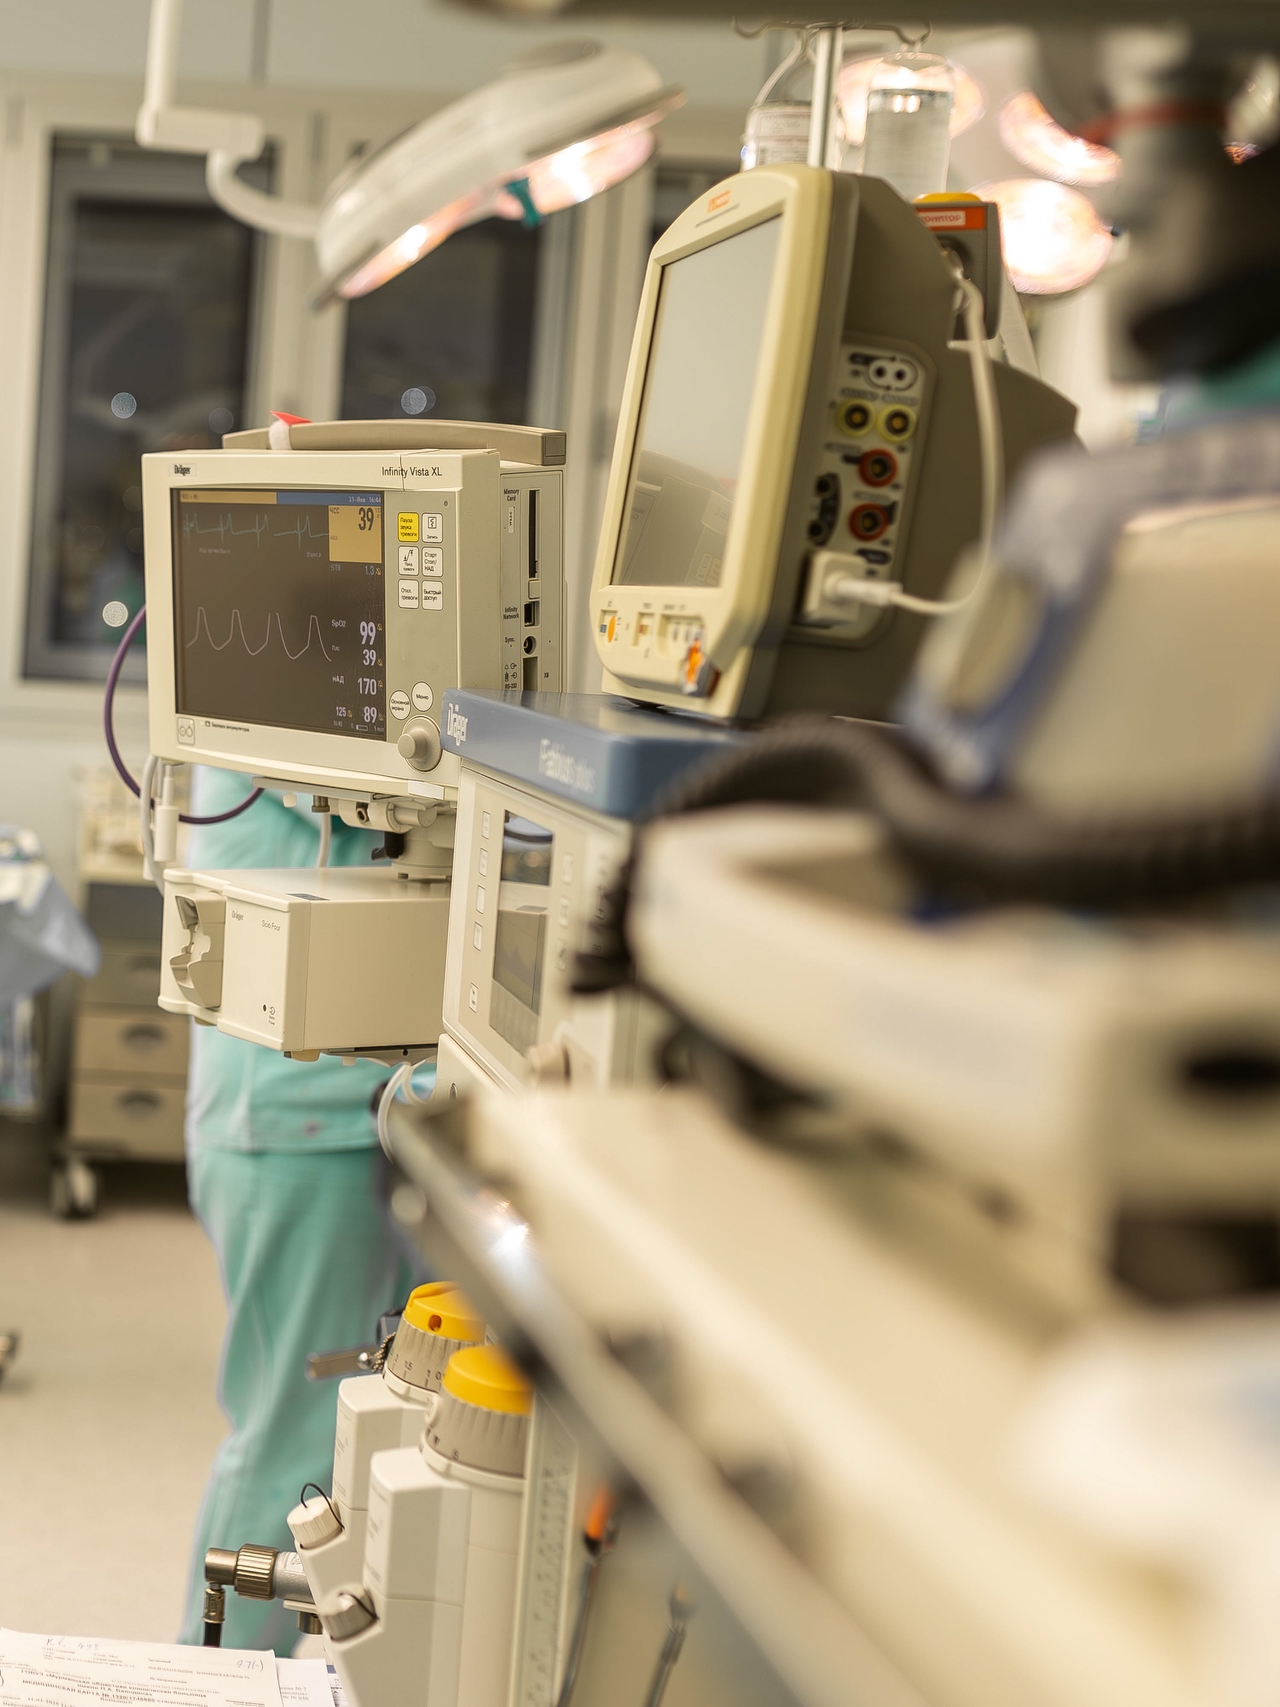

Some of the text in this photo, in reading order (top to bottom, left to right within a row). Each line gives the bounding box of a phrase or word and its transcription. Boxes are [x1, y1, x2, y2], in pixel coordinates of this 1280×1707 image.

[921, 214, 962, 223] ОНИТОР
[382, 466, 443, 479] Infinity Vista XL
[358, 507, 375, 531] 39
[423, 588, 442, 596] Быстрый
[359, 621, 376, 645] 99
[362, 649, 377, 666] 39
[357, 677, 377, 696] 170
[335, 705, 378, 724] 125 89
